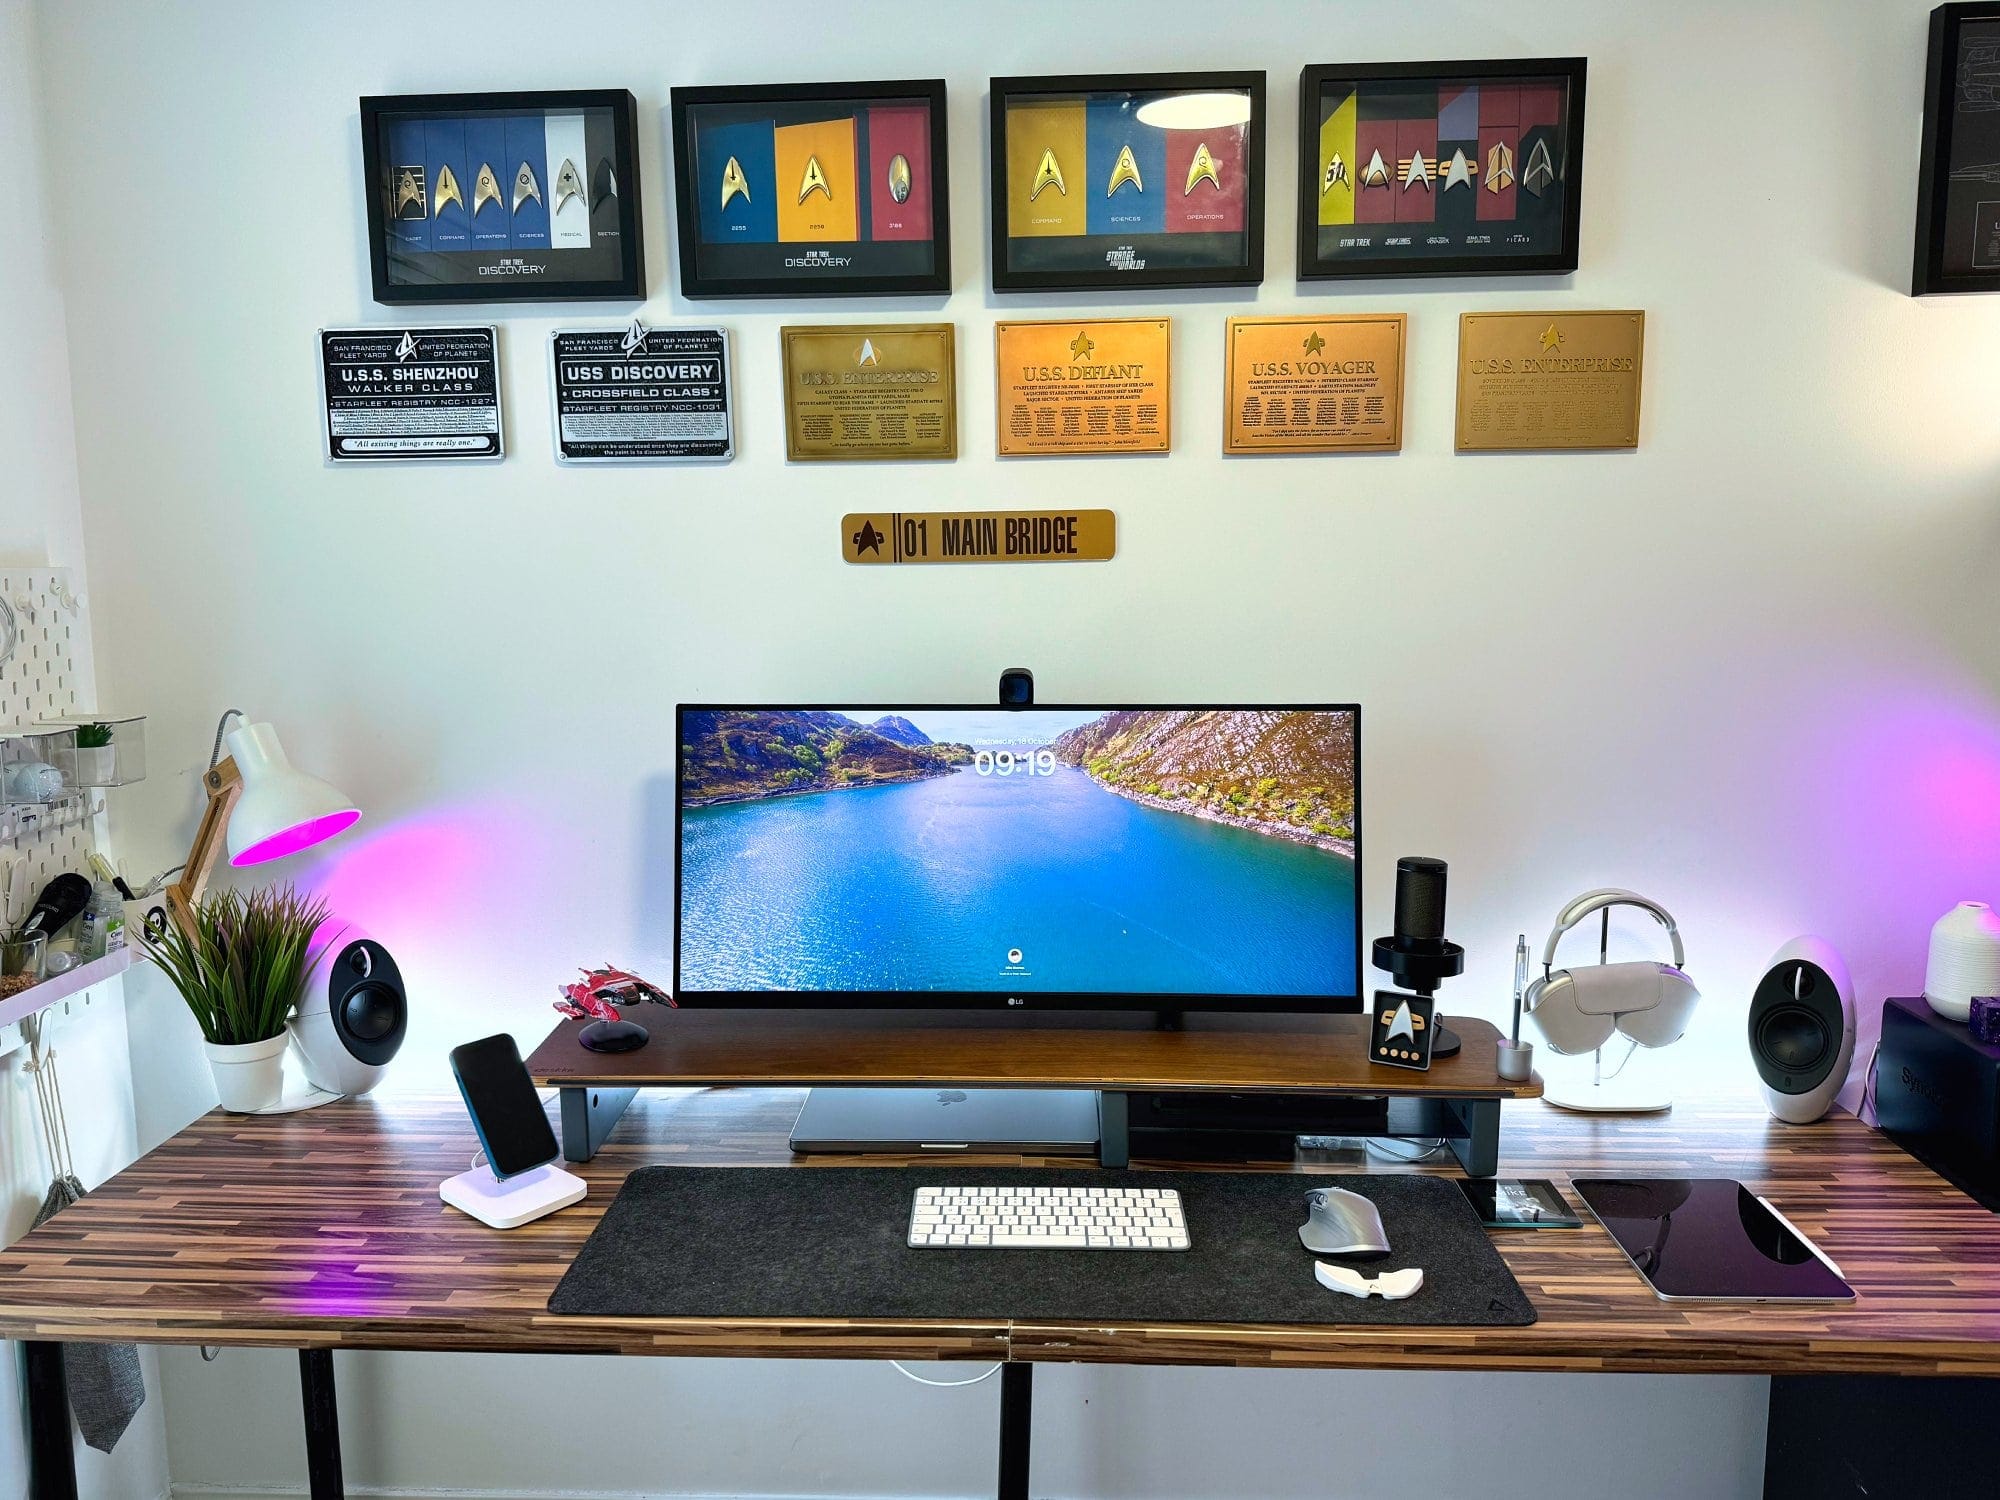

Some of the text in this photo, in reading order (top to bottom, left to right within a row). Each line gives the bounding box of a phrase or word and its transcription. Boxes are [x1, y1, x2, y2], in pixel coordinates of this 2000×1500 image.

[1340, 239, 1371, 247] STAR TREK
[1106, 250, 1136, 261] STRANGE
[785, 258, 851, 267] DISCOVERY
[1118, 260, 1145, 270] WORLDS
[478, 265, 546, 275] DISCOVERY
[567, 364, 713, 380] USS DISCOVERY
[1252, 361, 1375, 376] U.S.S. VOYAGER
[1470, 358, 1633, 374] U.S.S. ENTERPRISE
[341, 367, 479, 381] U.S.S. SHENZHOU
[843, 371, 939, 385] ENTERPRISE
[1023, 365, 1143, 381] U.S.S. DEFIANT
[347, 383, 473, 393] WALKER CLASS
[572, 388, 710, 398] CROSSFIELD CLASS
[370, 440, 397, 448] existing
[399, 440, 420, 448] things
[435, 439, 457, 447] really
[904, 516, 1078, 557] 01 MAIN BRIDGE
[974, 750, 1057, 777] 09:19
